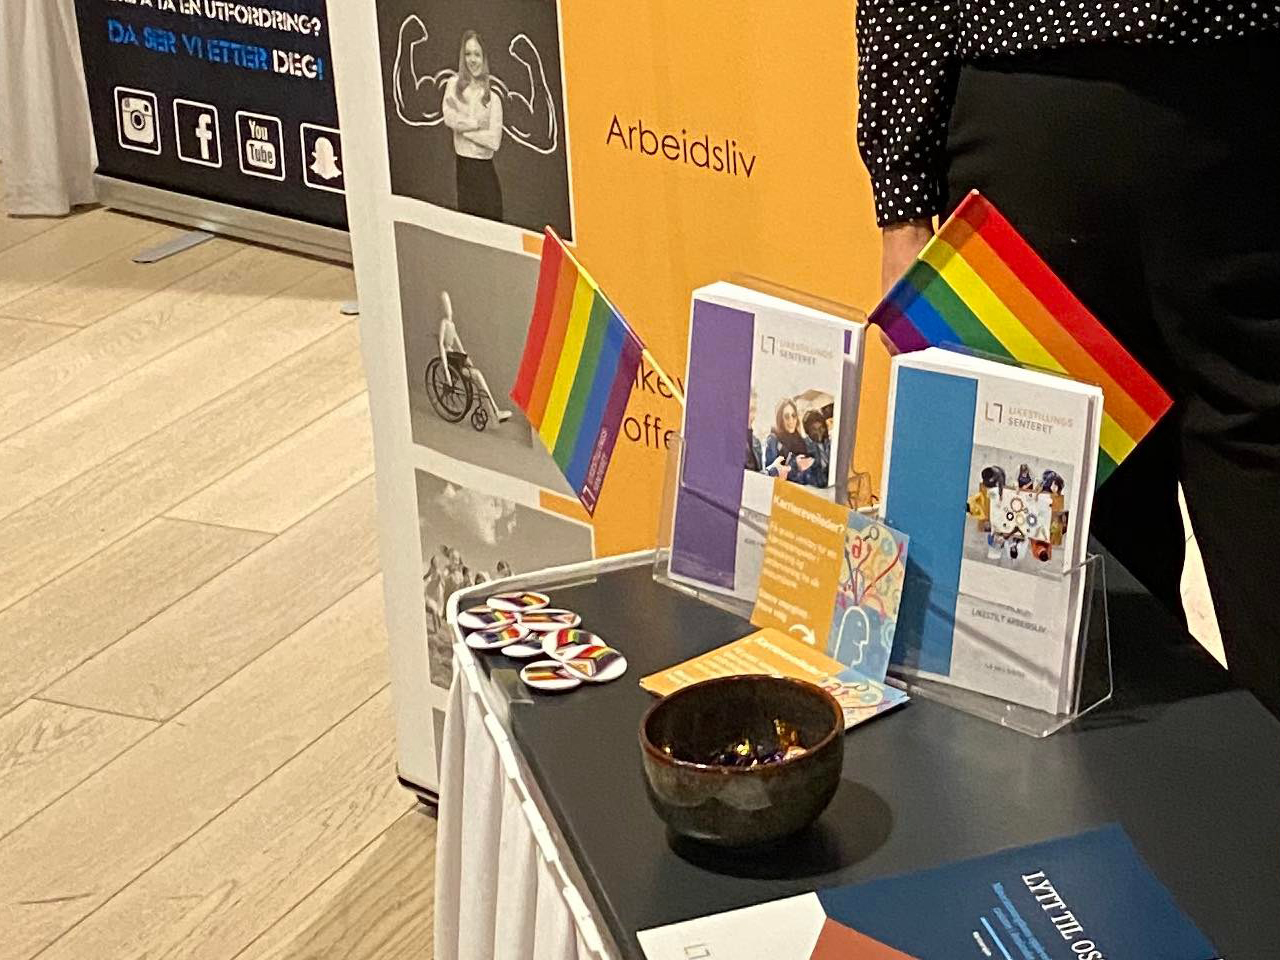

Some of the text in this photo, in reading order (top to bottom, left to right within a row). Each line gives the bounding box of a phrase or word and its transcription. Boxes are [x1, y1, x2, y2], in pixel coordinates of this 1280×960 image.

[107, 19, 324, 81] DA SER VI ETTER DEG!
[248, 119, 269, 140] You
[249, 142, 275, 165] Tube
[606, 114, 757, 179] Arbeidsliv
[1021, 870, 1067, 911] LYTT
[1050, 910, 1084, 941] TIL
